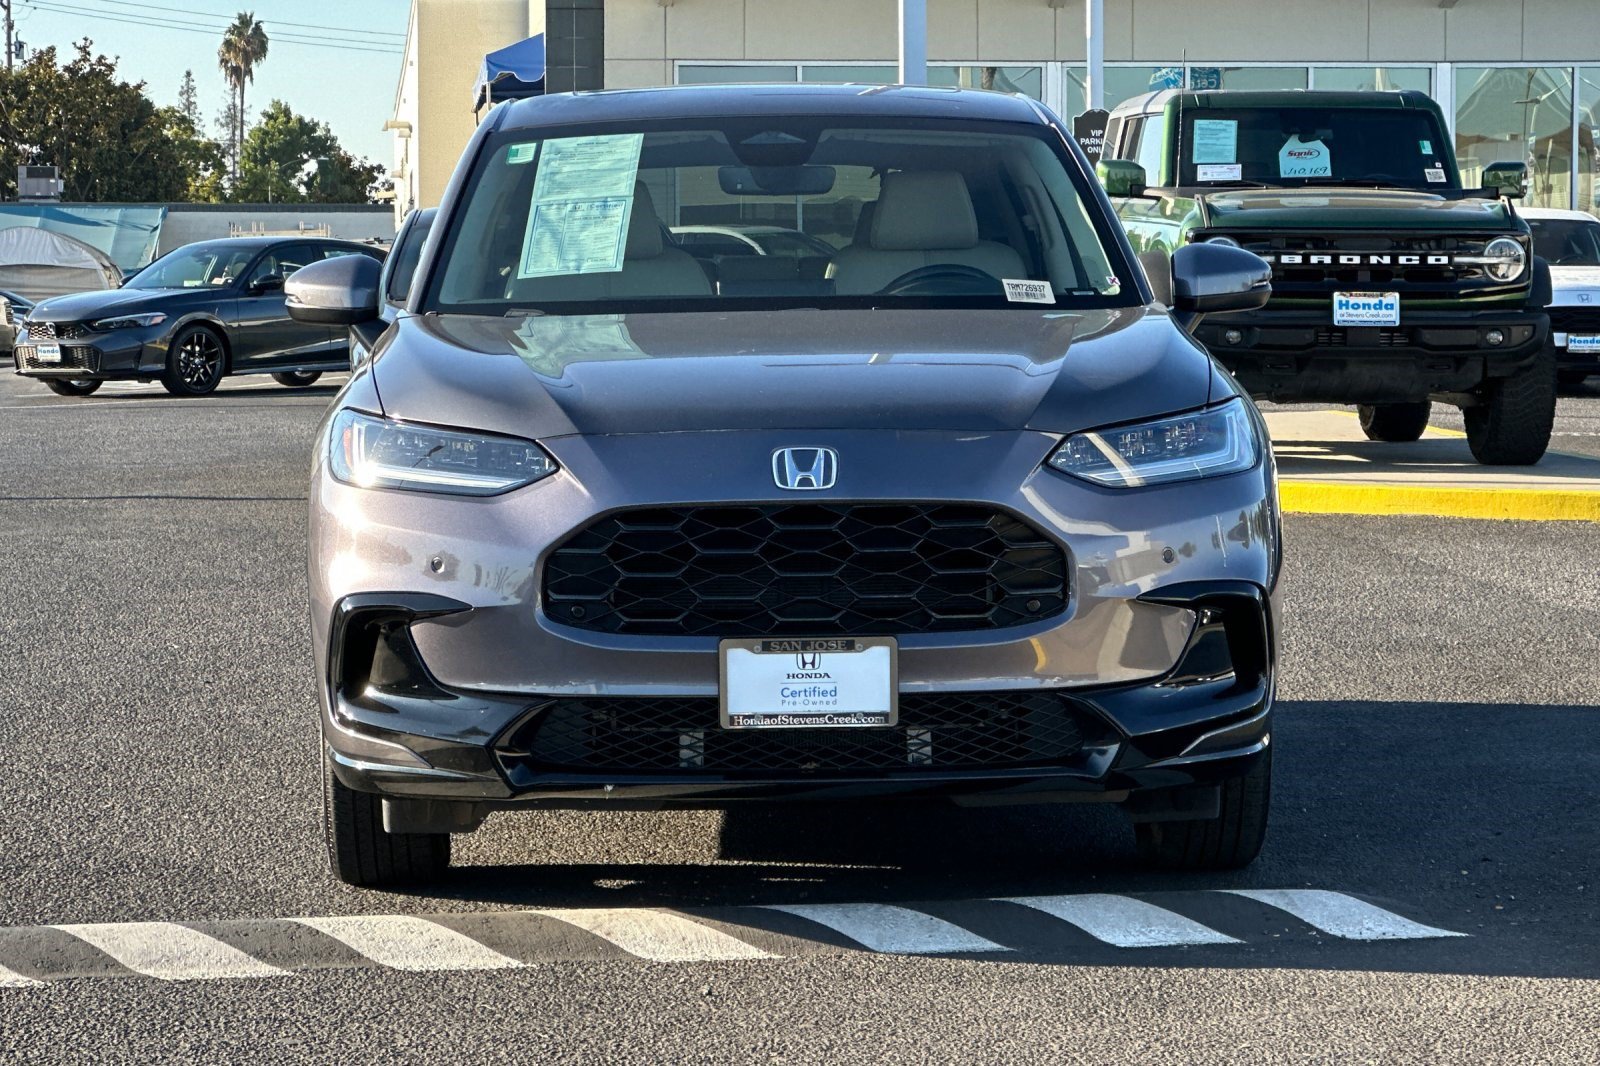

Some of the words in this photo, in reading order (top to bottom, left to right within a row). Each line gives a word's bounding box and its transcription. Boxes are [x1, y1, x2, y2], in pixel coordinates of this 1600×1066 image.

[1080, 137, 1104, 145] PARKI
[1087, 146, 1103, 154] ONL
[1280, 255, 1449, 264] BRONCO
[1006, 282, 1046, 293] TRM726937
[1338, 299, 1395, 311] Honda
[770, 641, 801, 652] SAN
[806, 640, 847, 651] JOSE
[785, 672, 832, 680] HONDA
[780, 686, 837, 698] Certified
[734, 714, 884, 725] HondaofStevensCreek.com
